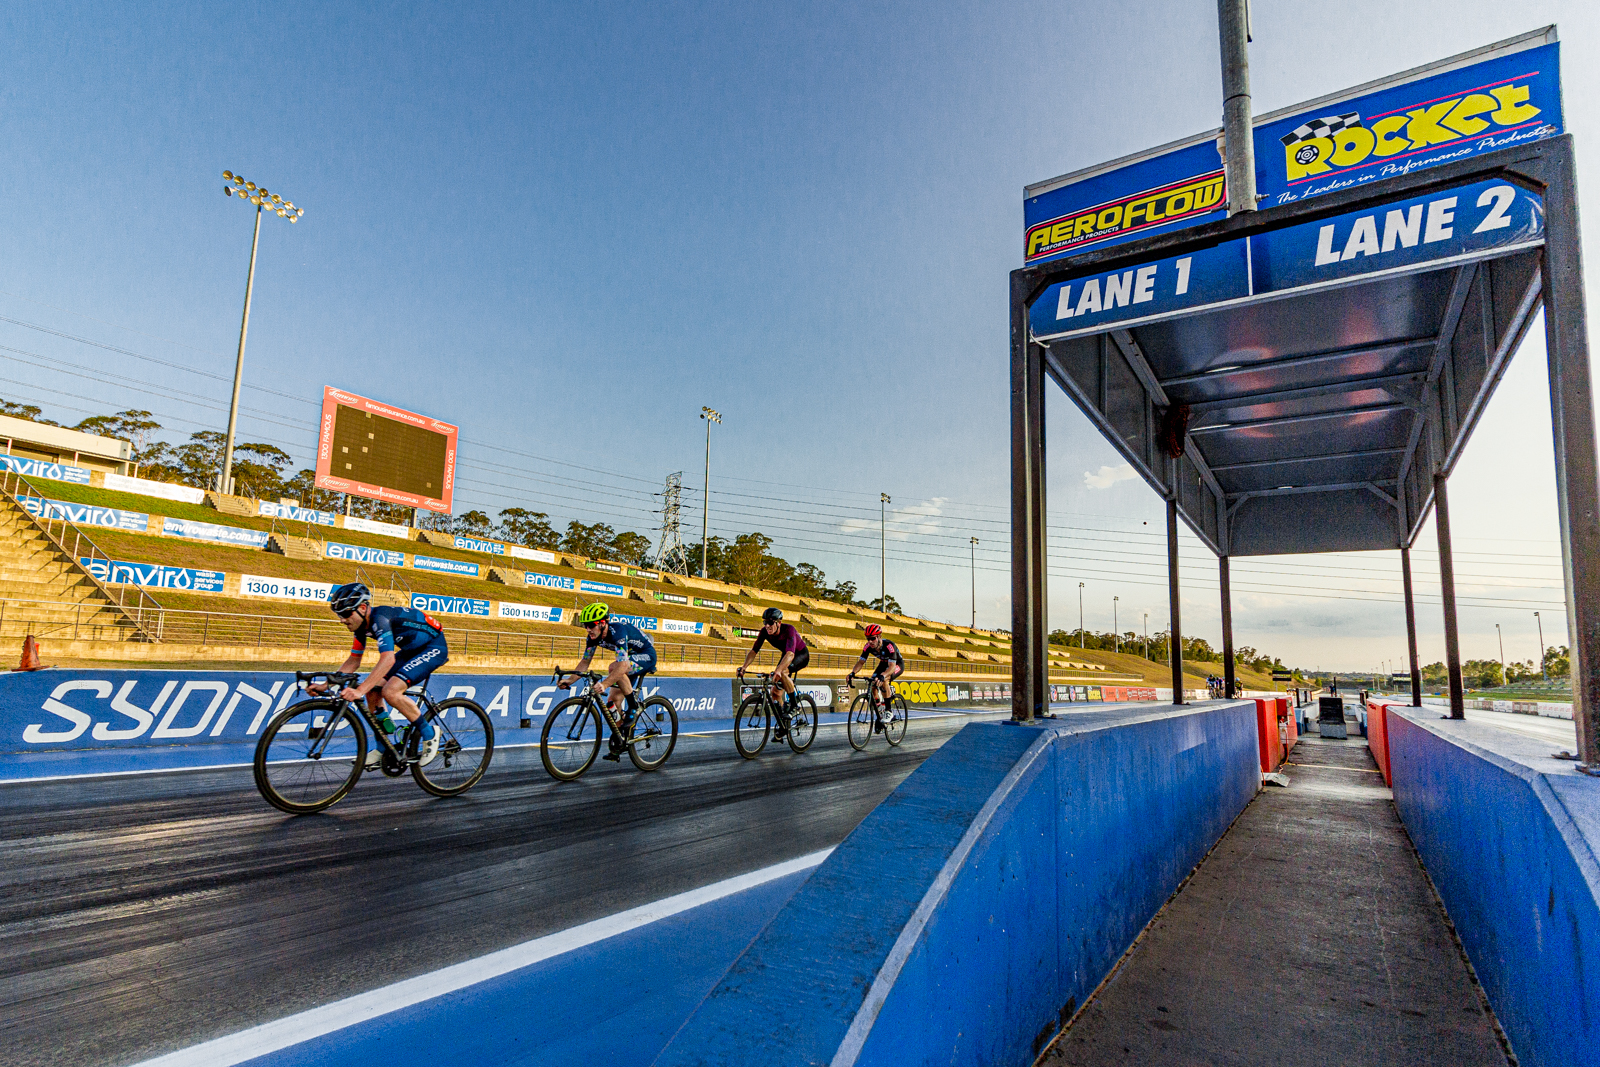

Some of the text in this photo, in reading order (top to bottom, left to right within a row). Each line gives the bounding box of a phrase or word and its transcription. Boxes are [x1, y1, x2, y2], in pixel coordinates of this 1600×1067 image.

[1276, 124, 1551, 204] The Leaders in Performance Products
[1027, 175, 1225, 256] AEROFLOW
[1314, 185, 1516, 267] LANE 2
[1039, 226, 1119, 252] PERFORMANCE PRODUCTS
[1056, 257, 1192, 321] LANE 1
[365, 401, 425, 425] famousinsurance.com.au
[321, 414, 332, 460] 1300 FAMOUS
[260, 503, 317, 523] enviro
[164, 521, 265, 544] envirowaste.com.au
[328, 545, 386, 564] enviro
[455, 538, 493, 553] enviro
[85, 563, 191, 589] enviro
[415, 558, 477, 573] envirowaste.com.au
[247, 582, 326, 599] 1300 14 13 15
[526, 574, 562, 588] enviro
[413, 597, 471, 614] enviro
[502, 608, 521, 617] 1300
[532, 610, 539, 618] 13
[541, 611, 549, 619] 15
[403, 649, 441, 671] mainpac
